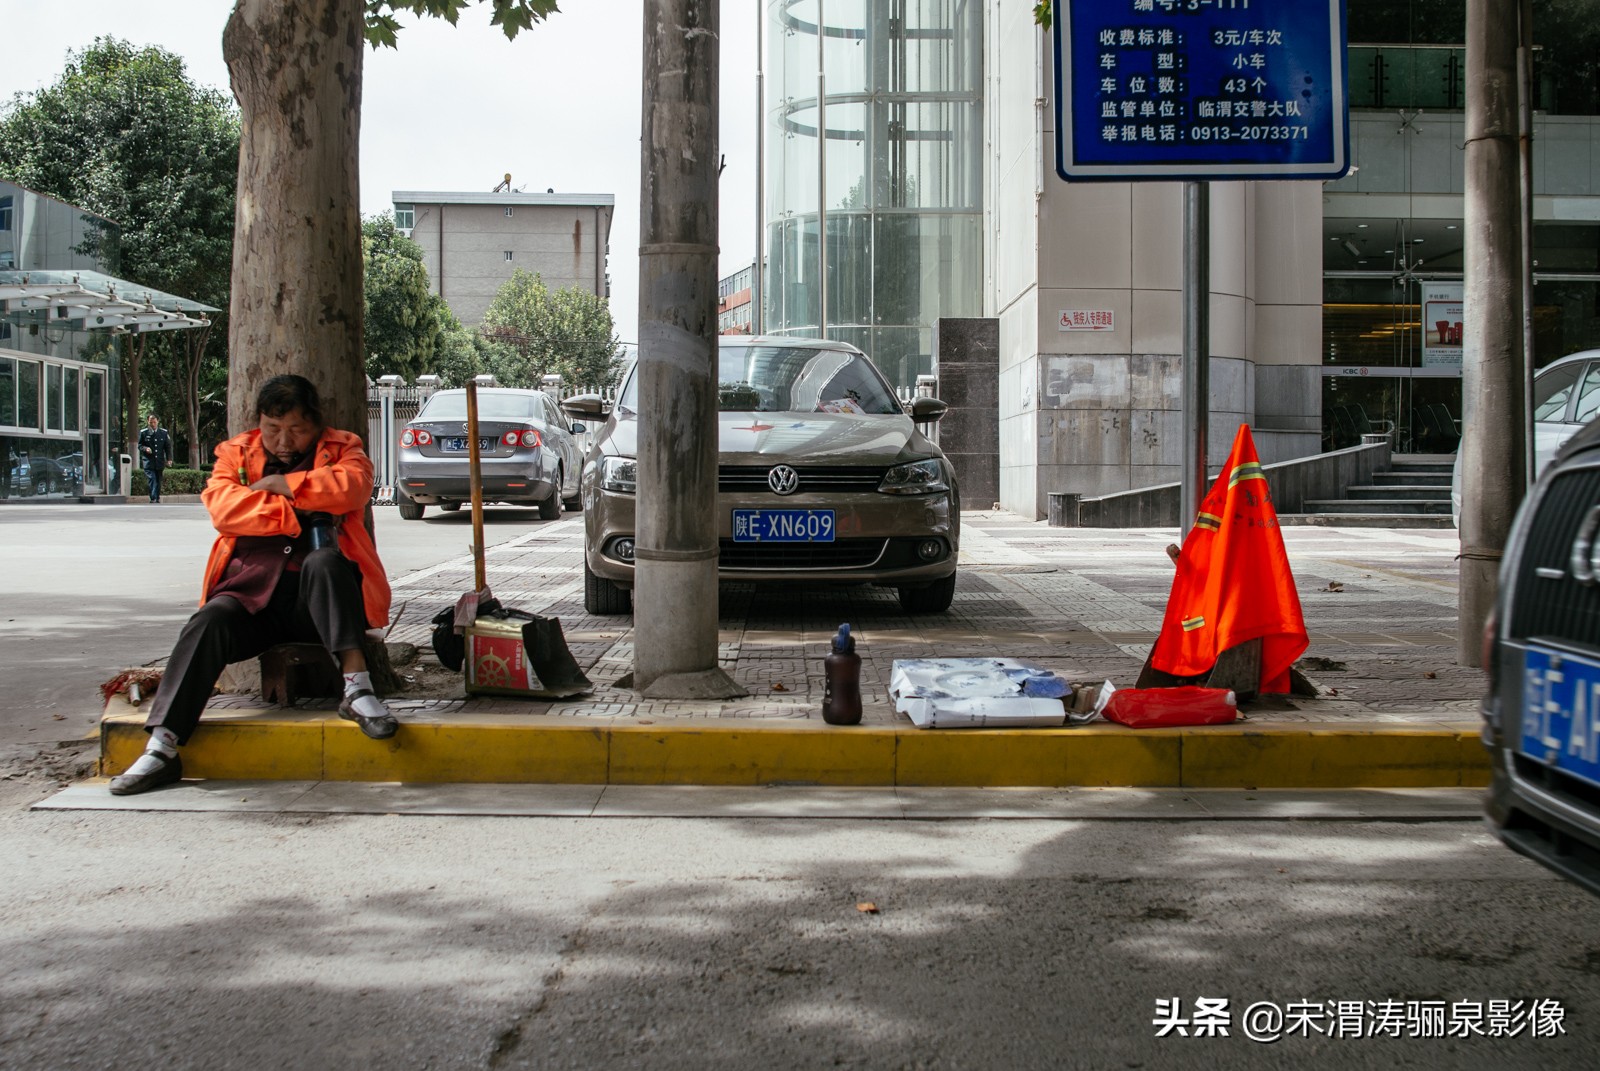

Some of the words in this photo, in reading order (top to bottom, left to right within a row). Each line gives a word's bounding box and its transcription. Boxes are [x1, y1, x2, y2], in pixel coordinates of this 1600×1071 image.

[1100, 30, 1184, 46] 收费标准：
[1214, 30, 1282, 46] 3元/车次
[1232, 53, 1266, 69] 小车
[1225, 77, 1267, 93] 43个
[1102, 101, 1185, 117] 监管单位：
[1198, 101, 1302, 117] 临渭交警大队
